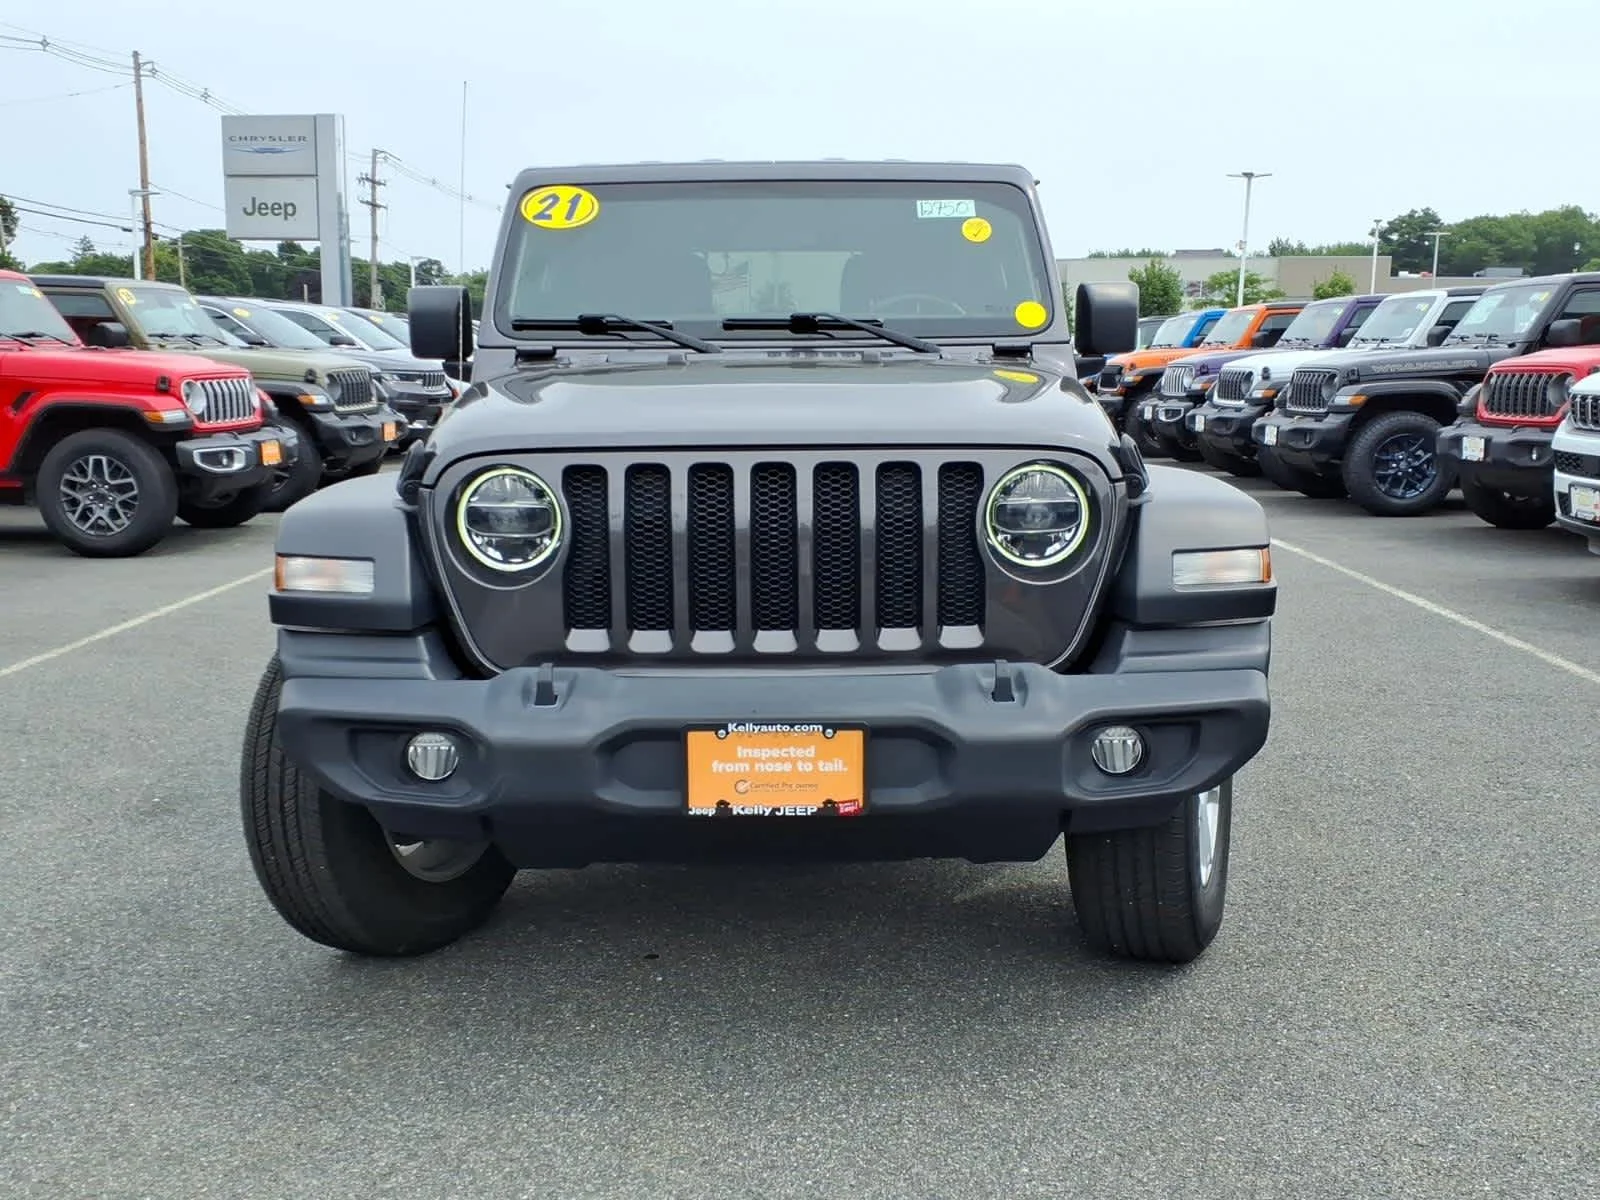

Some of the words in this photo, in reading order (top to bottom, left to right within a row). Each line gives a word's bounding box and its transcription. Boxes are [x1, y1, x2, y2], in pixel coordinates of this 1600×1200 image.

[242, 196, 297, 221] Jeep
[532, 193, 582, 220] 21
[1371, 359, 1478, 373] WRANGLER
[727, 722, 823, 734] Kellyauto.com
[737, 745, 816, 760] Inspected
[712, 760, 749, 773] from
[755, 762, 792, 773] nose
[797, 760, 813, 773] to
[818, 759, 848, 773] tail.
[688, 806, 716, 816] Jeep
[732, 805, 772, 816] Kelly
[775, 805, 818, 816] JEEP
